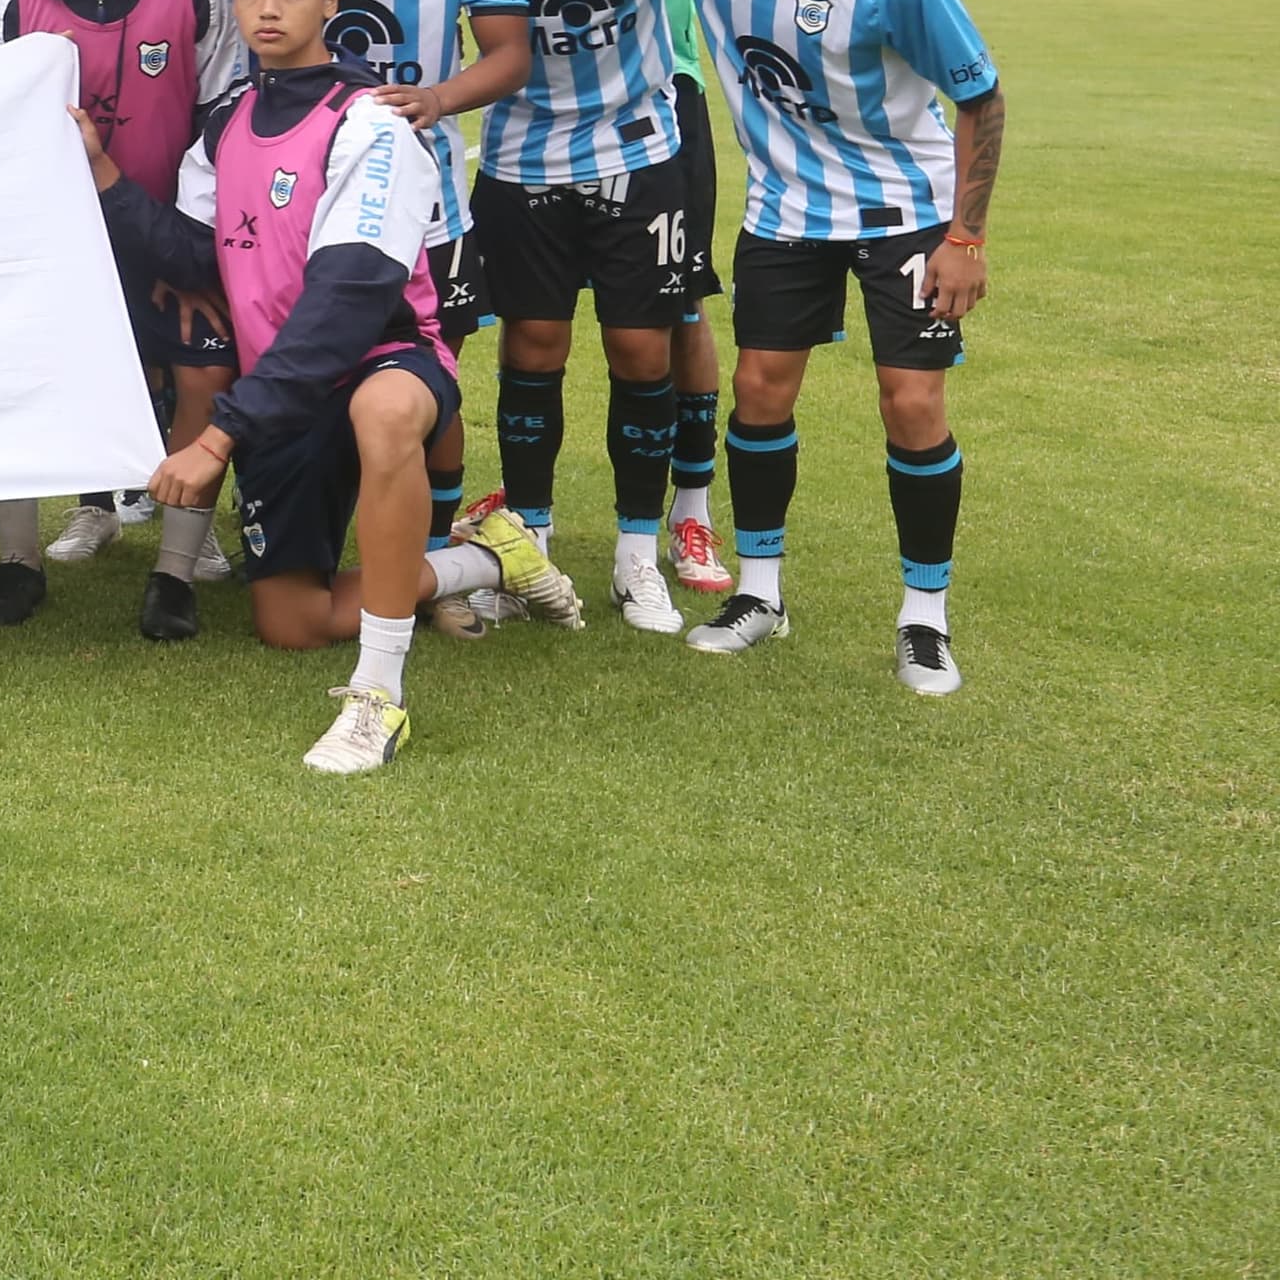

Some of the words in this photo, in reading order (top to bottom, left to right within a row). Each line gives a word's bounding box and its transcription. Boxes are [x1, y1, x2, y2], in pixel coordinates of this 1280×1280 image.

[647, 209, 686, 266] 16
[443, 295, 477, 309] KDY
[919, 329, 955, 339] KDY
